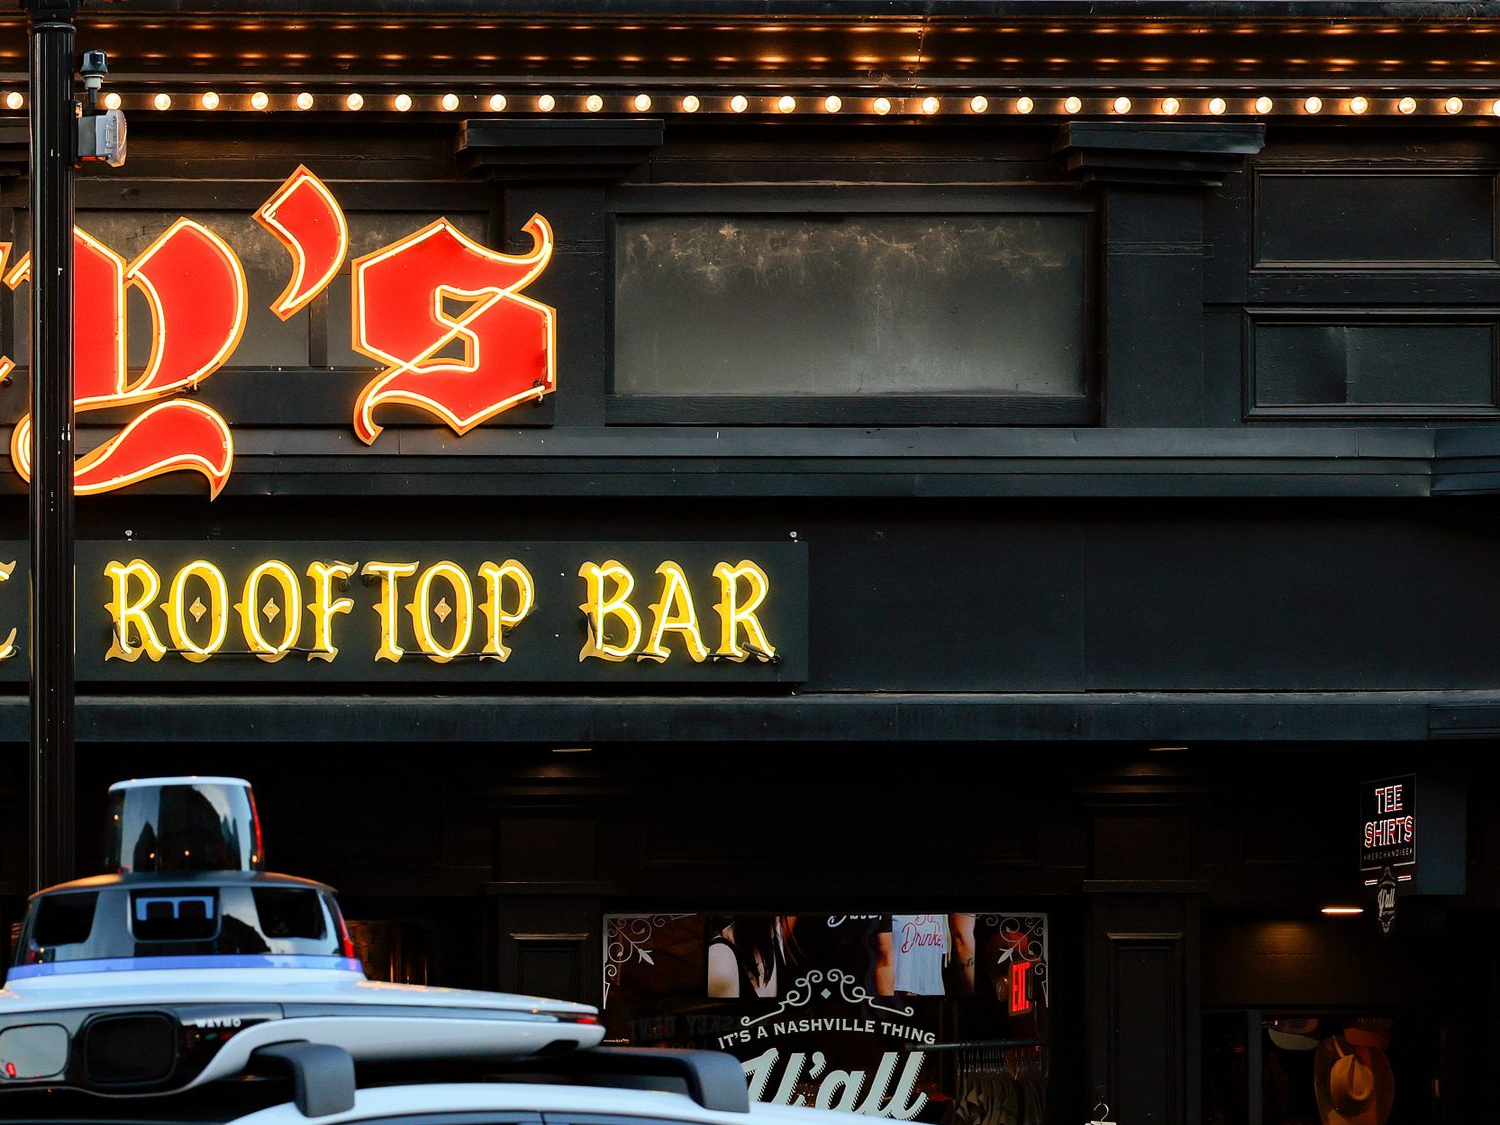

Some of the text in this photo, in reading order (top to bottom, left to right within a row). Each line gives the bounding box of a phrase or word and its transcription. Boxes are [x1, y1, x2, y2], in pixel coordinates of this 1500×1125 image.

[103, 558, 536, 664] ROOFTOP
[578, 558, 777, 664] BAR
[1375, 784, 1404, 814] TEE
[1364, 815, 1414, 848] SHIRTS
[195, 1016, 242, 1028] WAYMO
[718, 1029, 751, 1050] IT'S
[757, 1026, 768, 1039] A
[773, 1018, 875, 1036] NASHVILLE
[881, 1022, 936, 1045] THING
